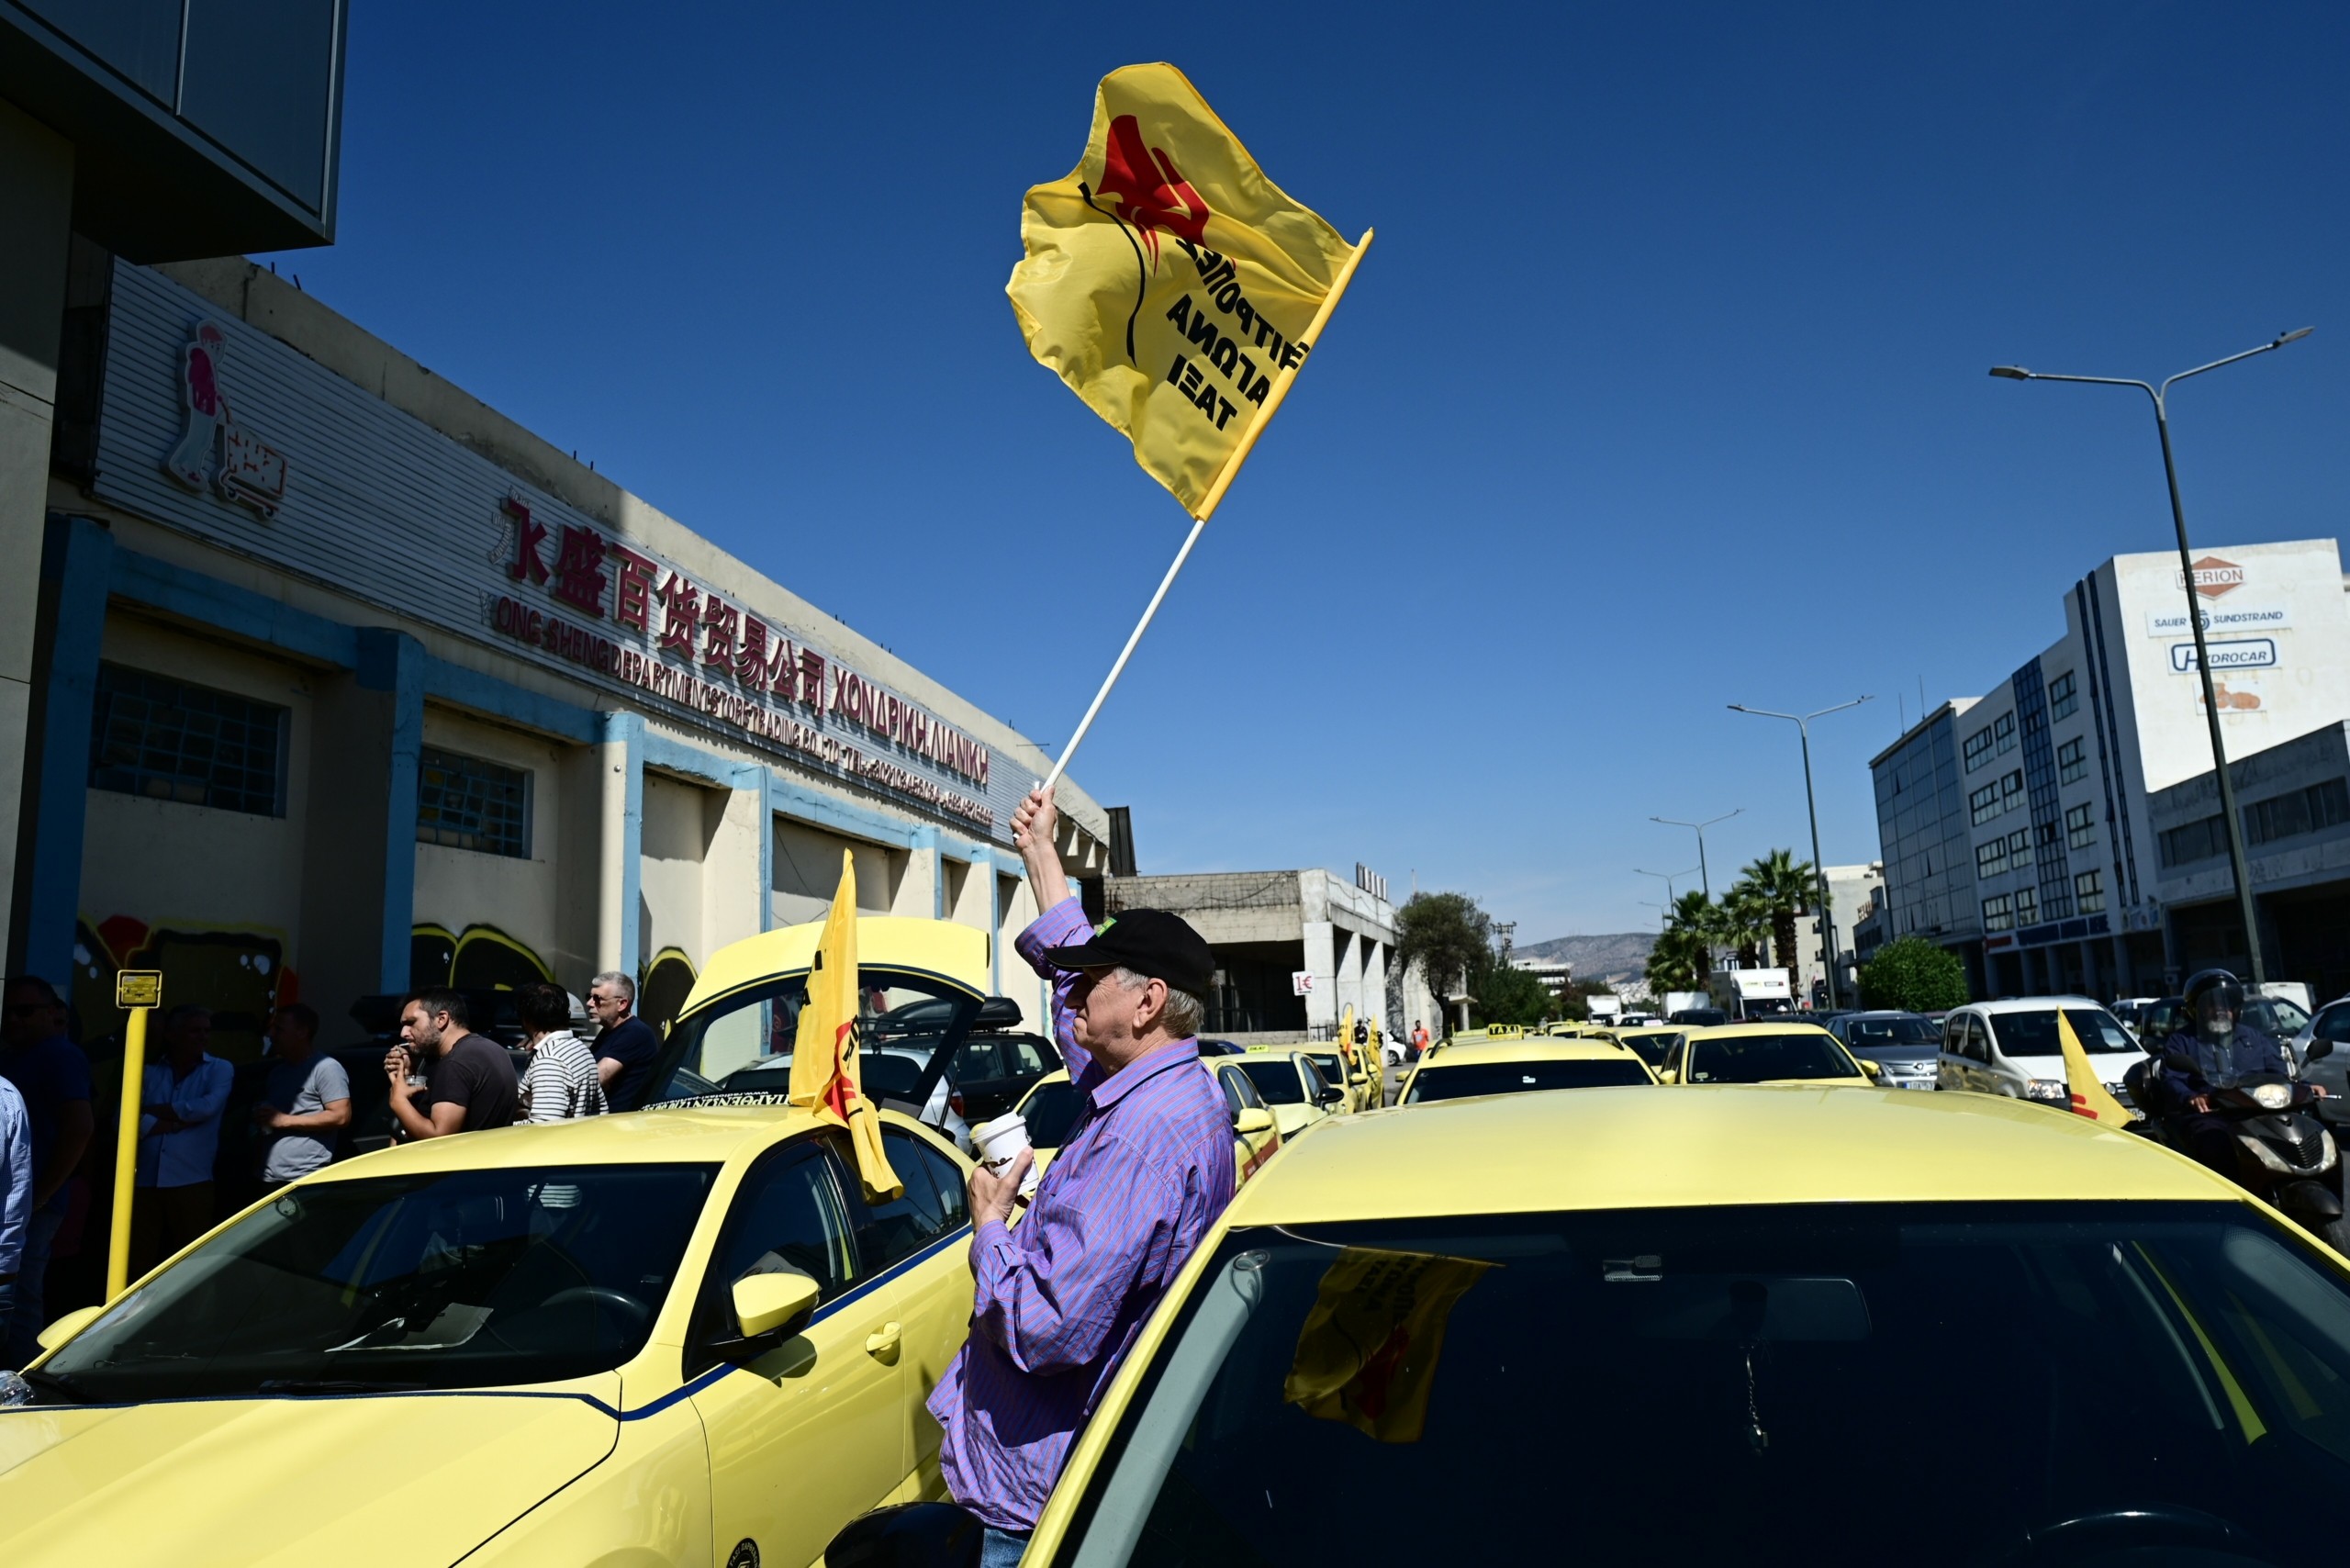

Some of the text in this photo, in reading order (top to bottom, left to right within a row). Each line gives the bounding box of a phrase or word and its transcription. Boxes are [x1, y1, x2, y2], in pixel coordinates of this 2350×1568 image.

[2154, 610, 2284, 628] SAUER SUNDSTRAND
[1295, 975, 1312, 991] 1€
[1491, 1025, 1517, 1035] TAXI
